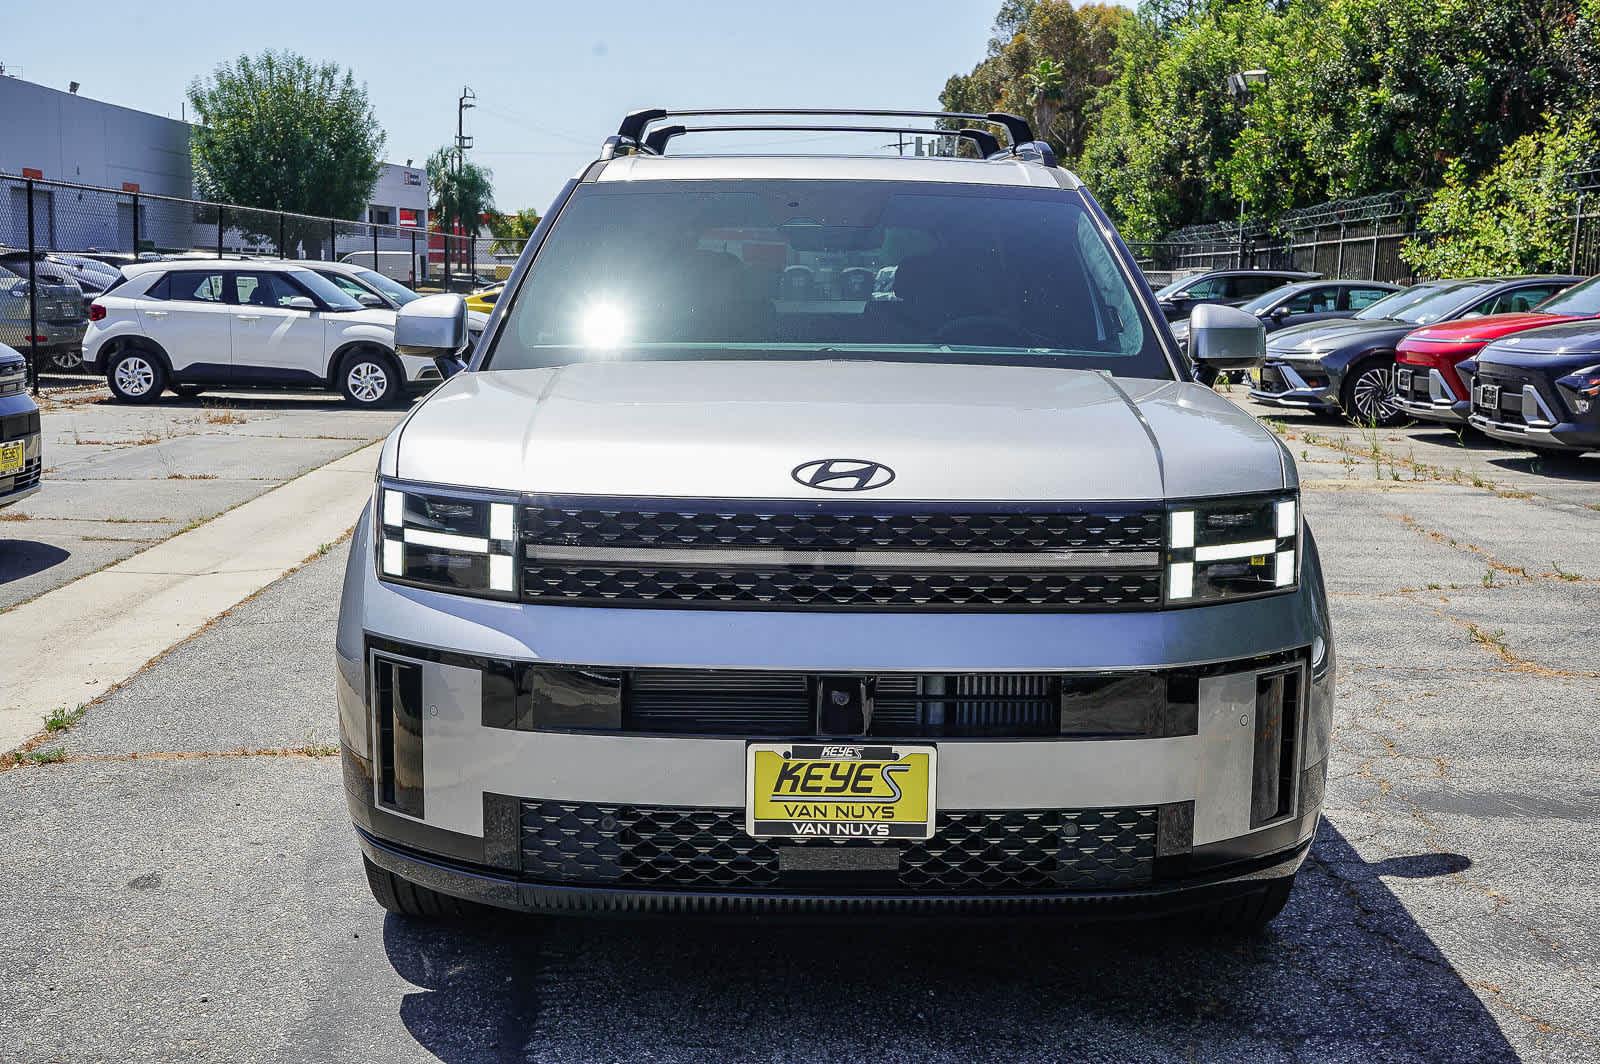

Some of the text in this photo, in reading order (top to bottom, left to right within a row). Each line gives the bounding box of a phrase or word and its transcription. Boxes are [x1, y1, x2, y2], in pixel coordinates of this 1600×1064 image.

[821, 746, 864, 759] KEYES
[769, 762, 911, 802] KEYES
[784, 804, 895, 819] VAN NUYS
[792, 823, 889, 836] VAN NUYS
